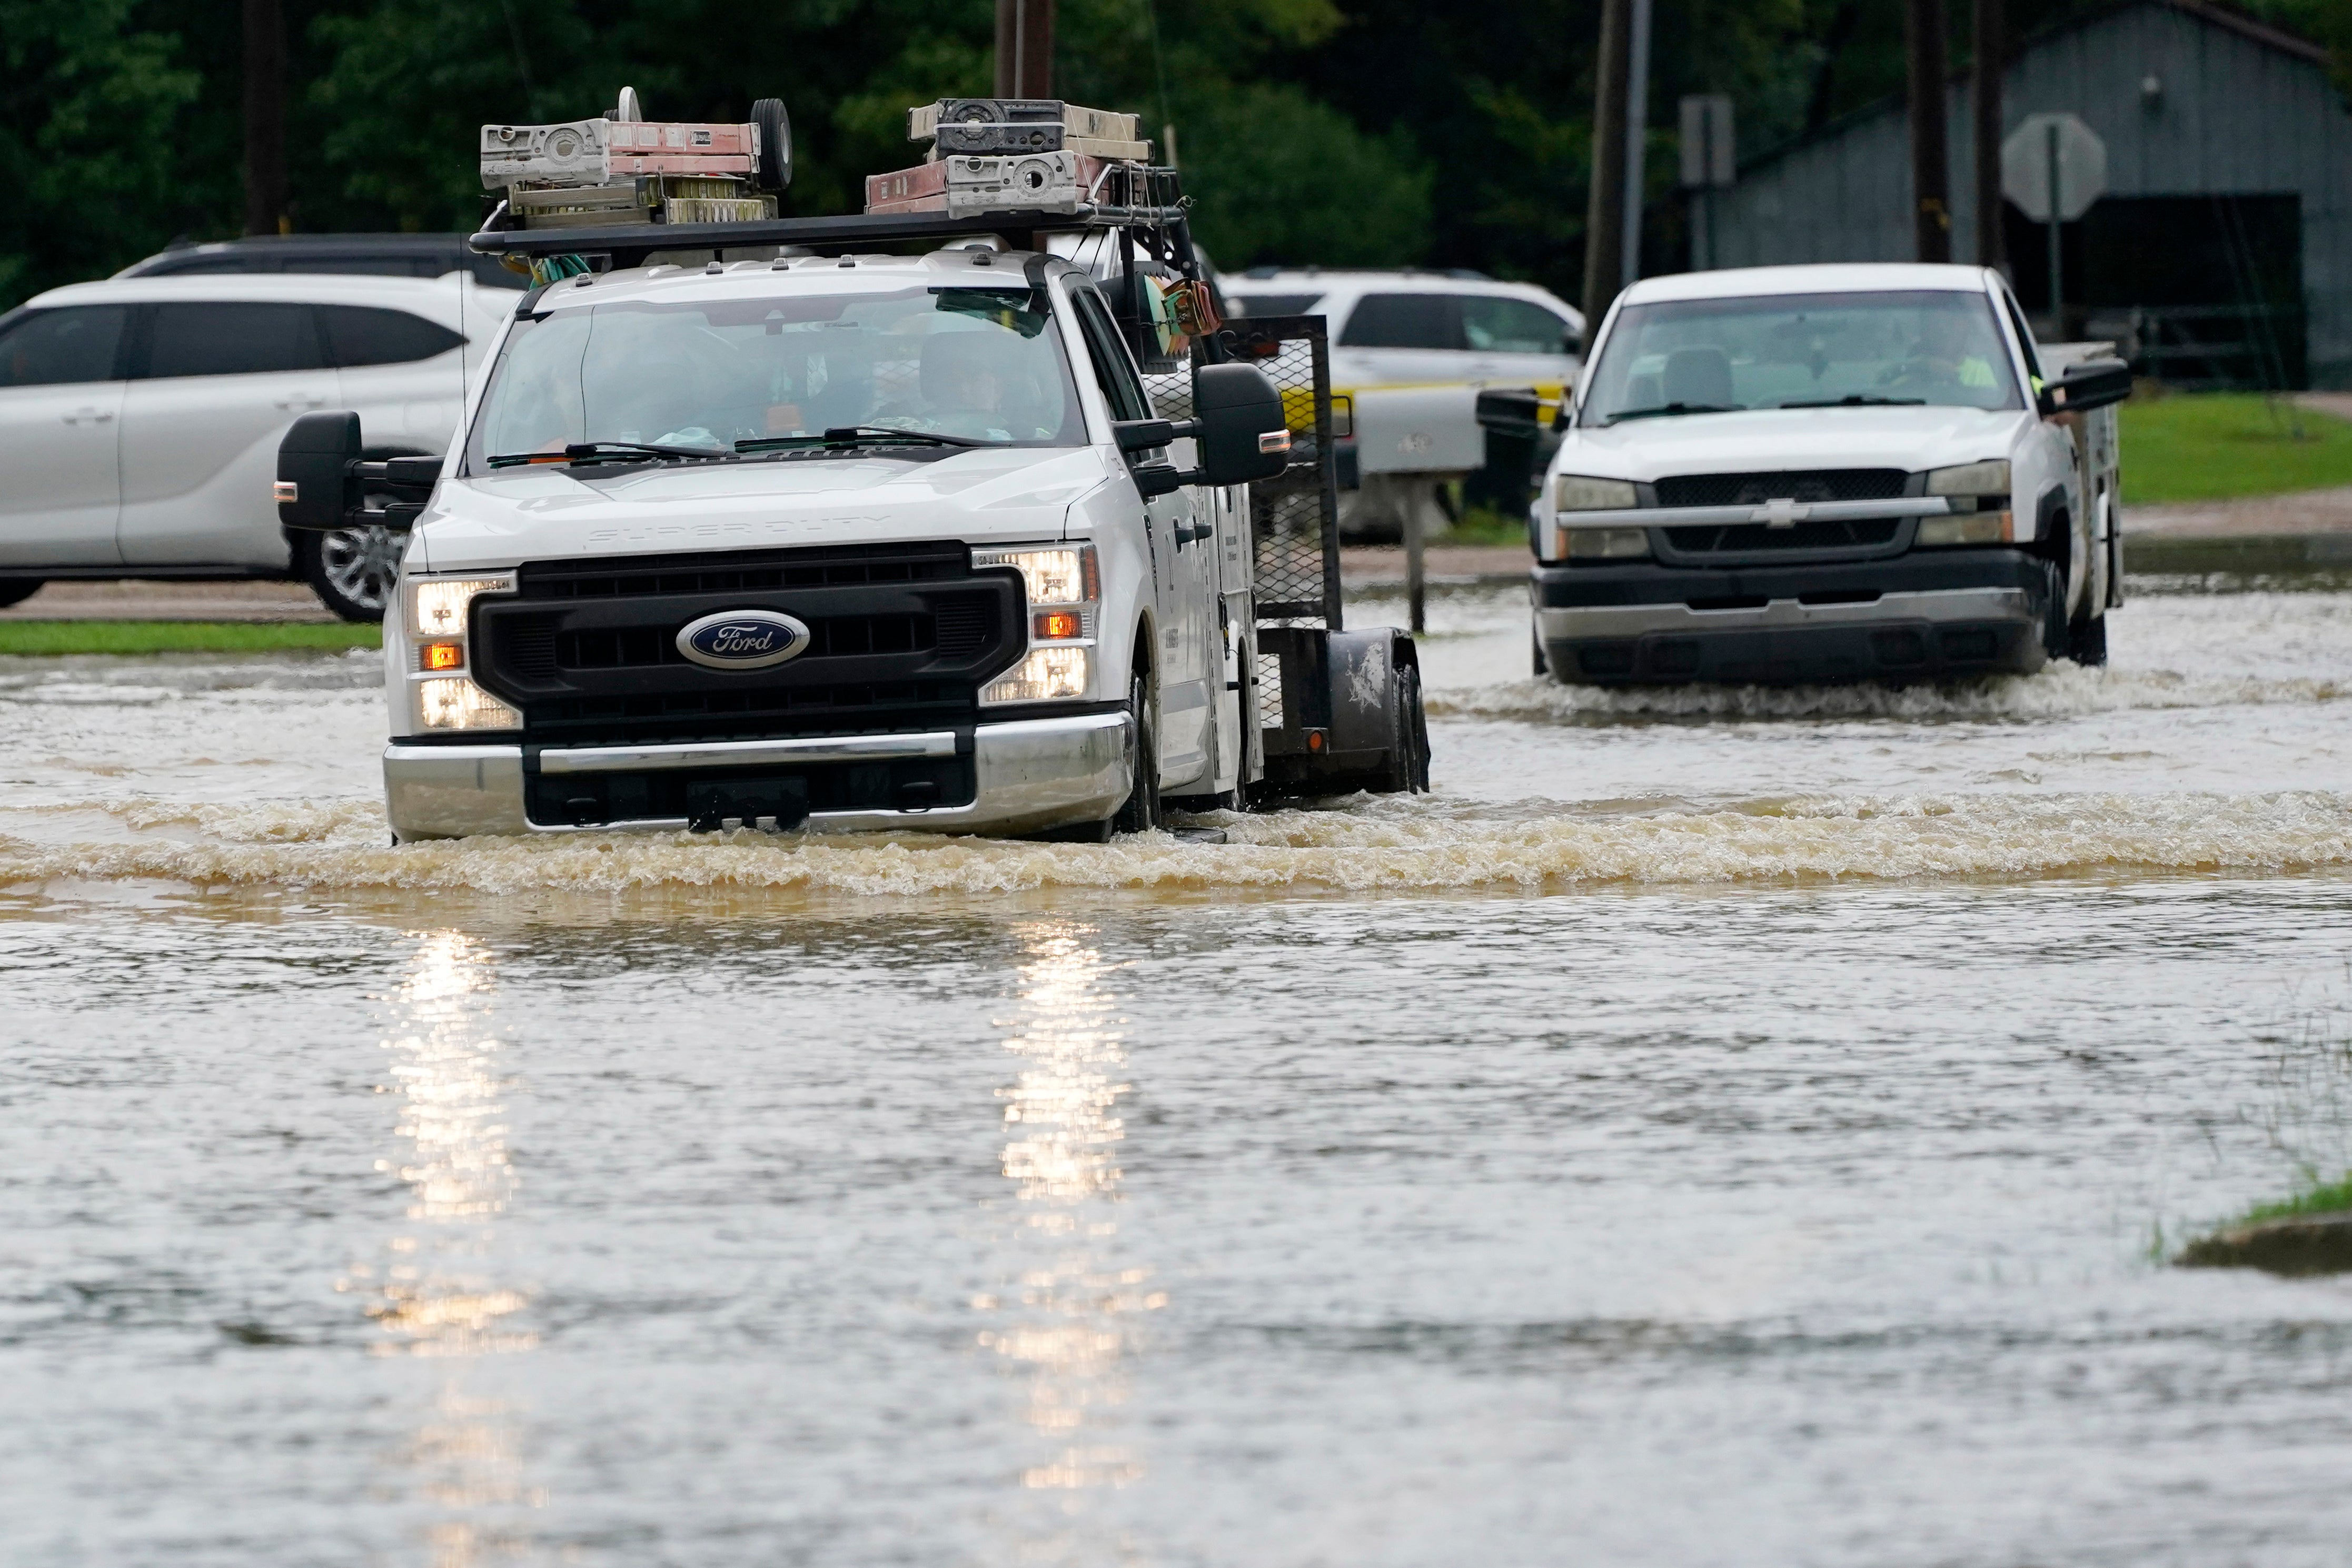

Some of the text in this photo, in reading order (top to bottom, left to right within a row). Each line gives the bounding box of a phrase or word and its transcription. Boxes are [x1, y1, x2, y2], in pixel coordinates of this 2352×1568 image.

[588, 515, 891, 542] SUPER DUTY
[712, 626, 773, 652] Ford
